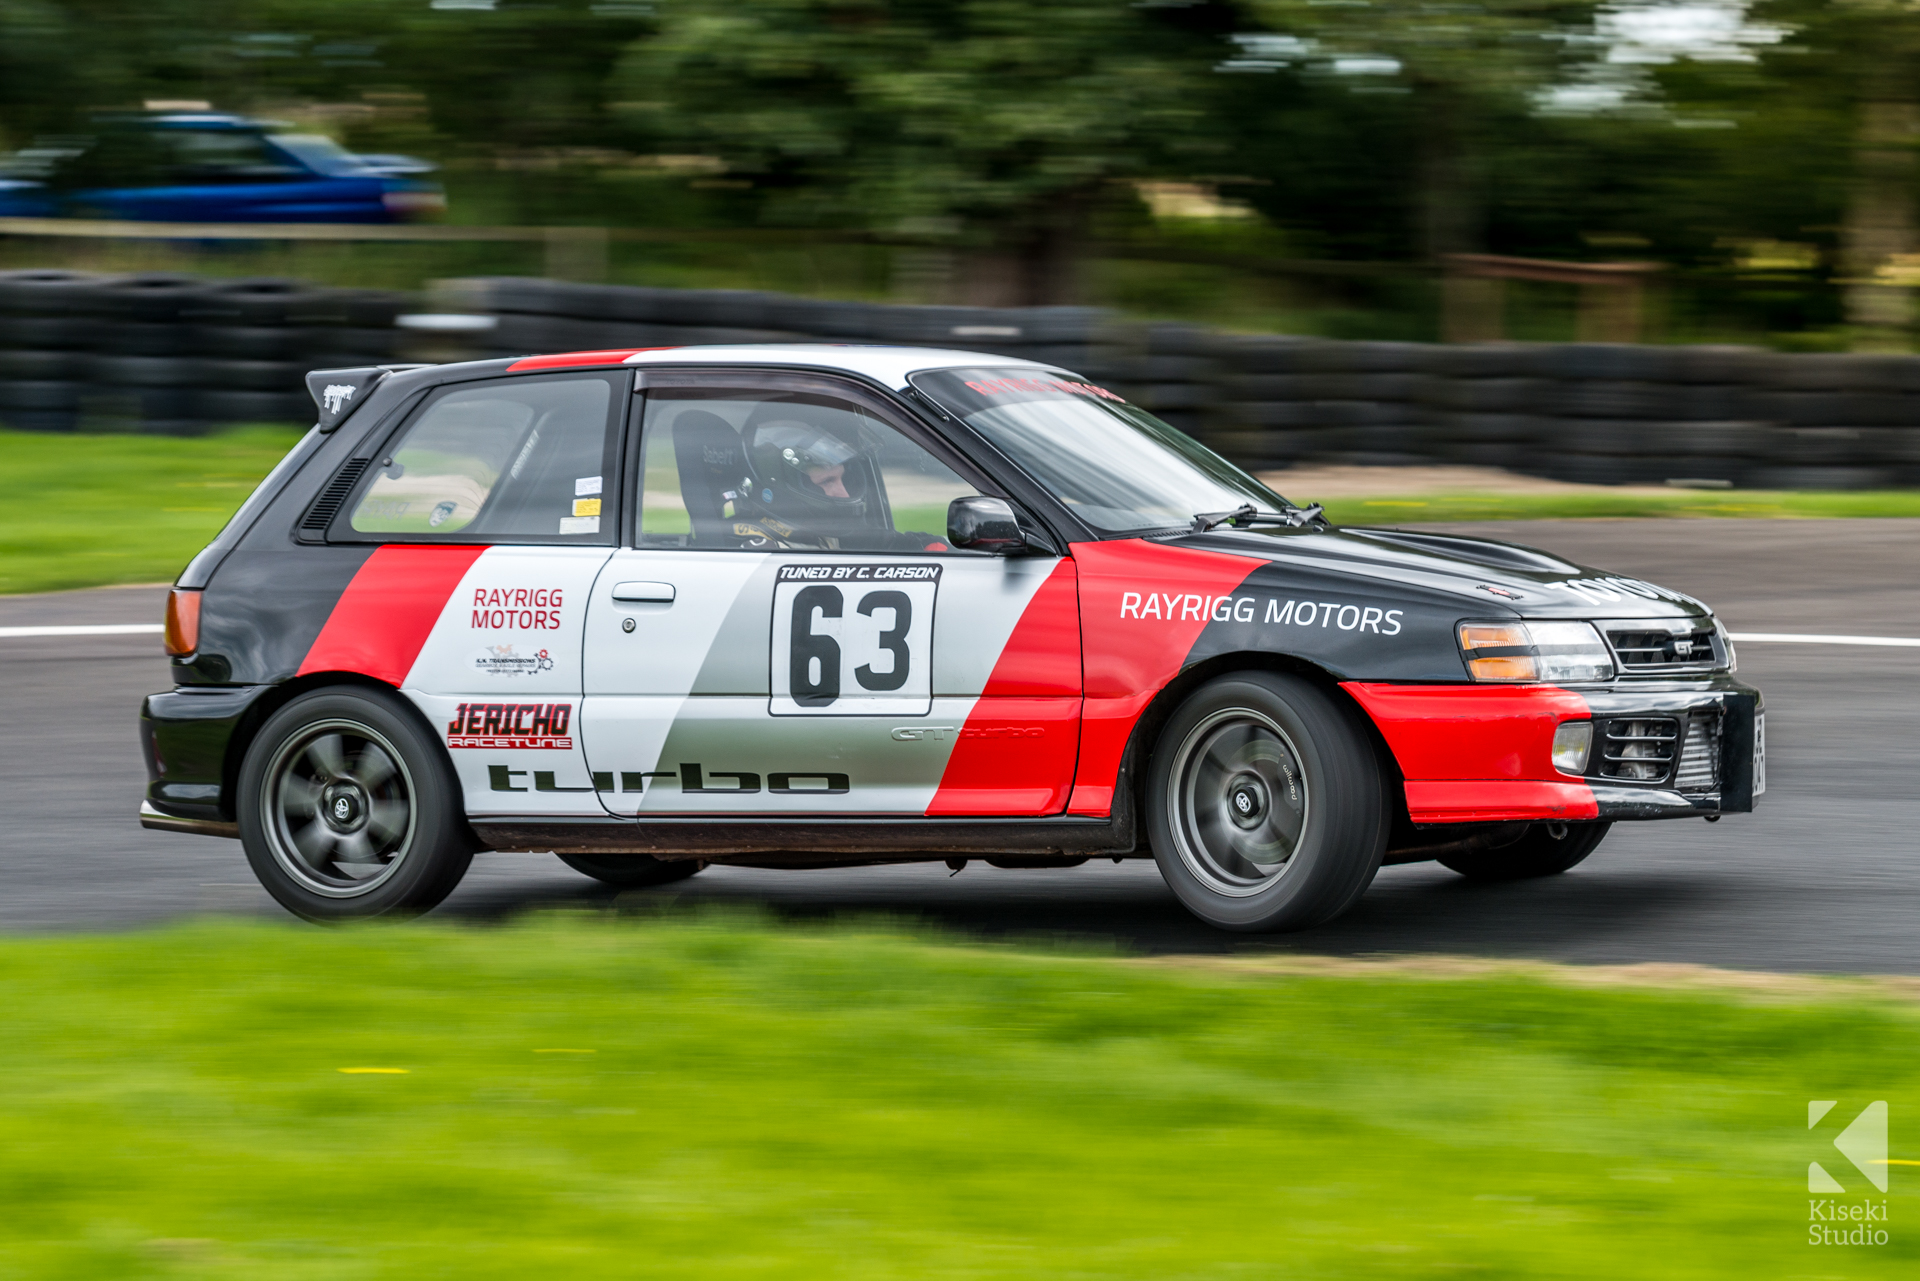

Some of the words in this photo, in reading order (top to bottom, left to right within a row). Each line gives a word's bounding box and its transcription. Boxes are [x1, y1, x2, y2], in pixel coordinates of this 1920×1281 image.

[964, 378, 1057, 396] RAYRIGG
[779, 567, 831, 580] TUNED
[832, 567, 857, 579] BY
[857, 567, 871, 579] C.
[873, 566, 940, 579] CARSON
[473, 588, 564, 608] RAYRIGG
[471, 609, 562, 630] MOTORS
[1120, 591, 1256, 623] RAYRIGG
[1264, 599, 1404, 636] MOTORS
[790, 585, 912, 707] 63
[448, 702, 572, 736] JERICHO
[448, 738, 572, 748] RACETUNE
[891, 726, 955, 741] GT
[957, 726, 1045, 739] turbo
[488, 763, 850, 795] turbo
[1282, 764, 1298, 801] wilwood
